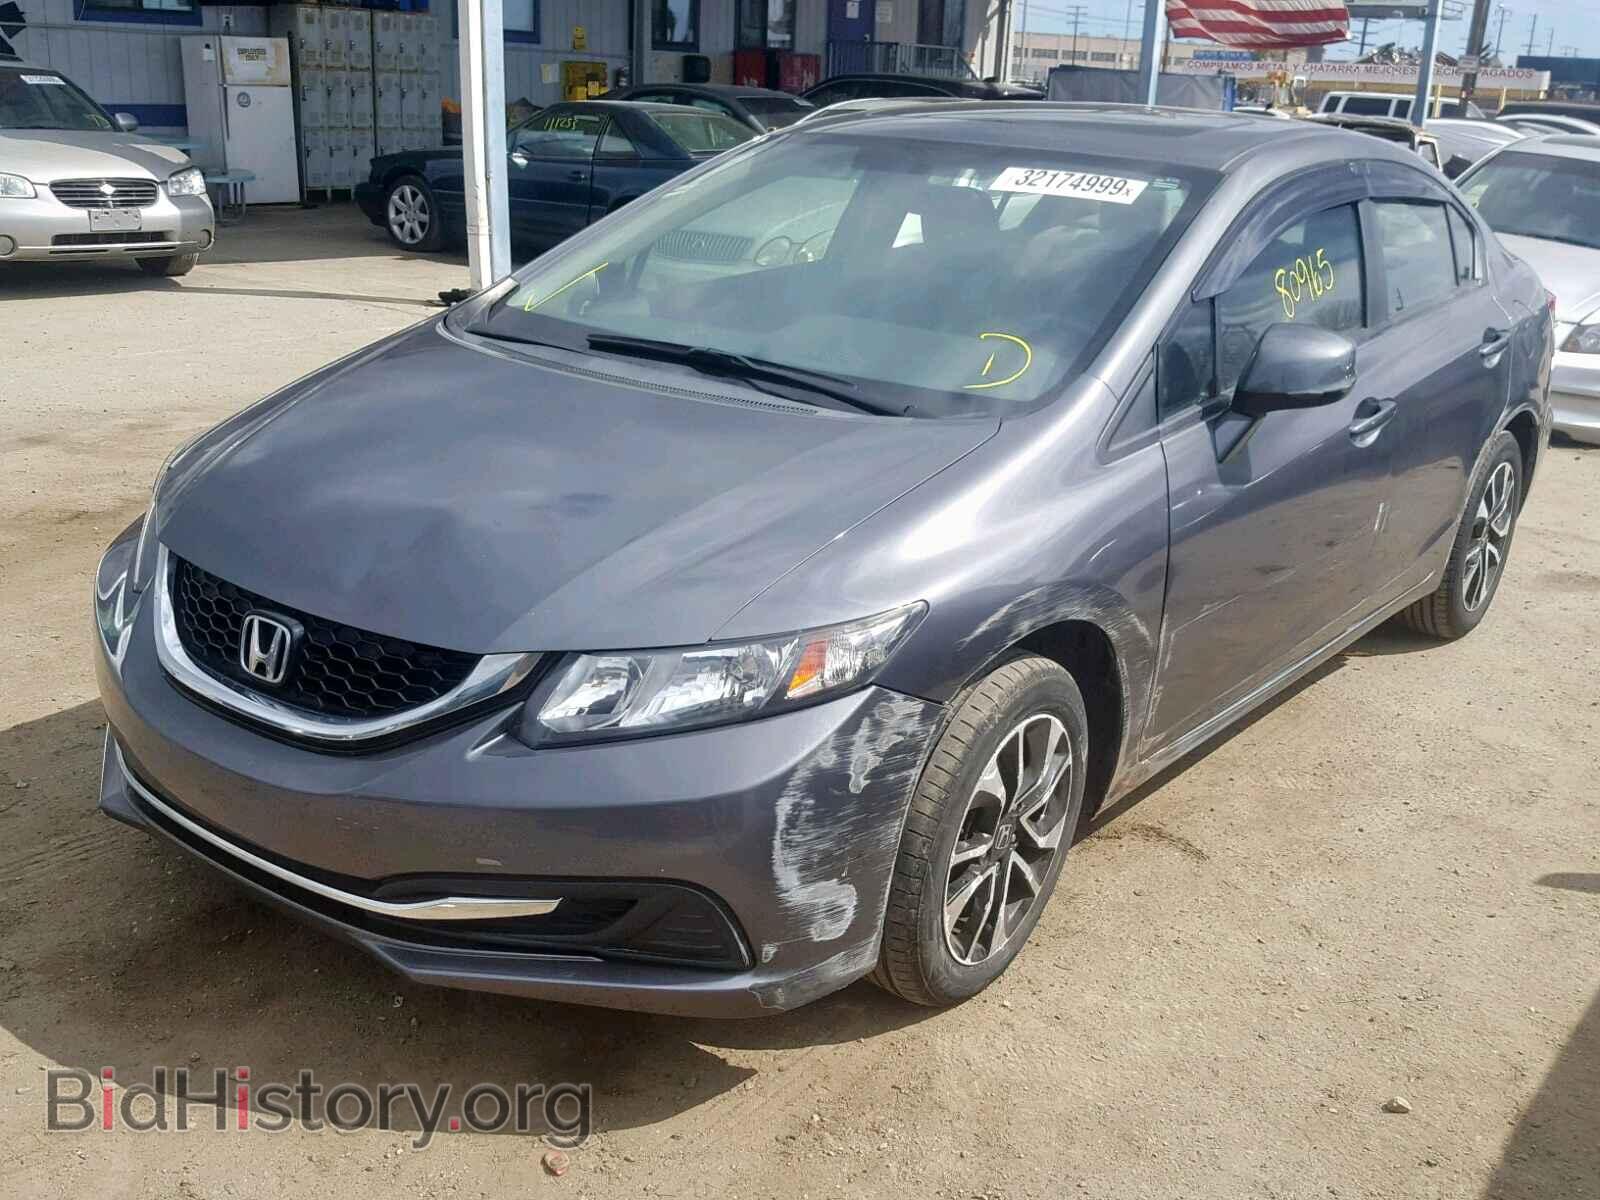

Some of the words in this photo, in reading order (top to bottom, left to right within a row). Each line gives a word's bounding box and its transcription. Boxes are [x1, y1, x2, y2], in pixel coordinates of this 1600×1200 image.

[1187, 60, 1253, 72] COMPRAMOS
[1256, 62, 1288, 73] METAL
[1303, 63, 1359, 74] CHATARRA
[1274, 248, 1334, 318] 80965
